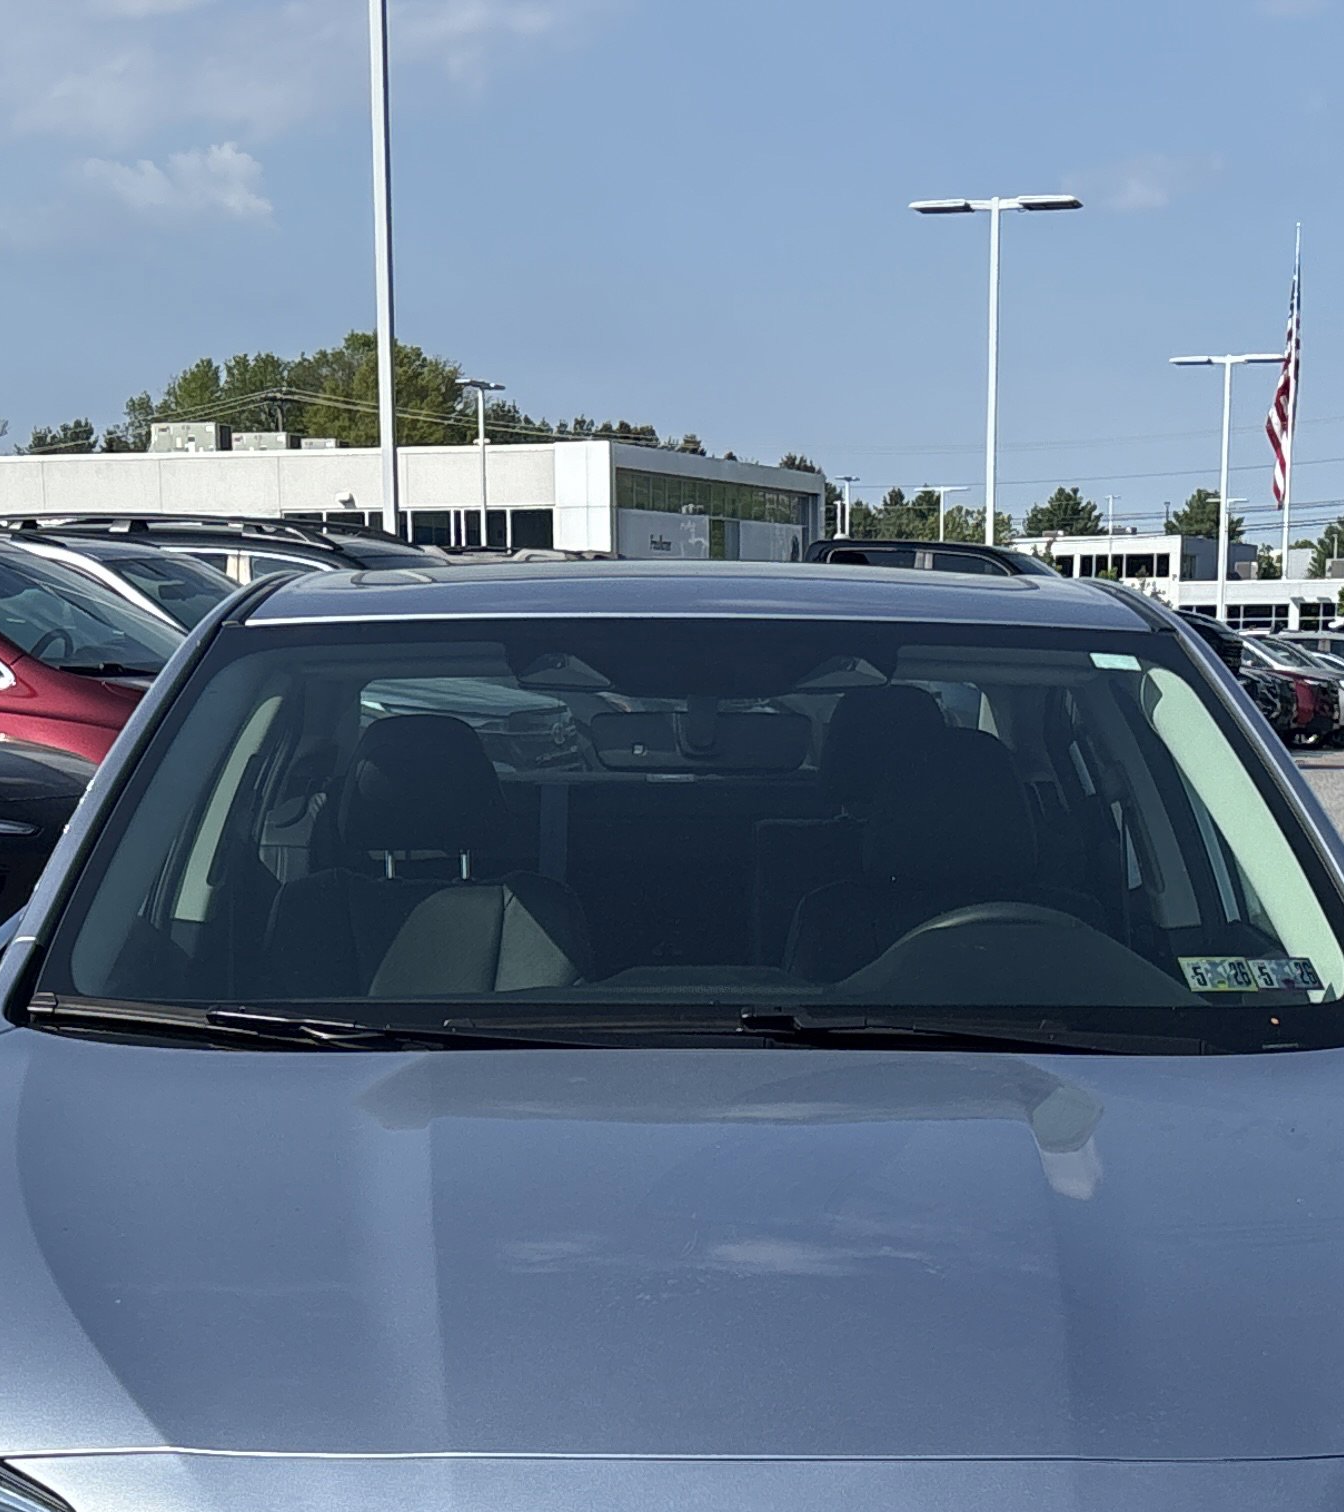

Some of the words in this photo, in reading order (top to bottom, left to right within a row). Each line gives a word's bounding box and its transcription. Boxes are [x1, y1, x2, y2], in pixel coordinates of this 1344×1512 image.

[1192, 965, 1207, 987] 5
[1228, 961, 1252, 986] 26
[1258, 965, 1274, 987] 5
[1294, 961, 1318, 985] 26
